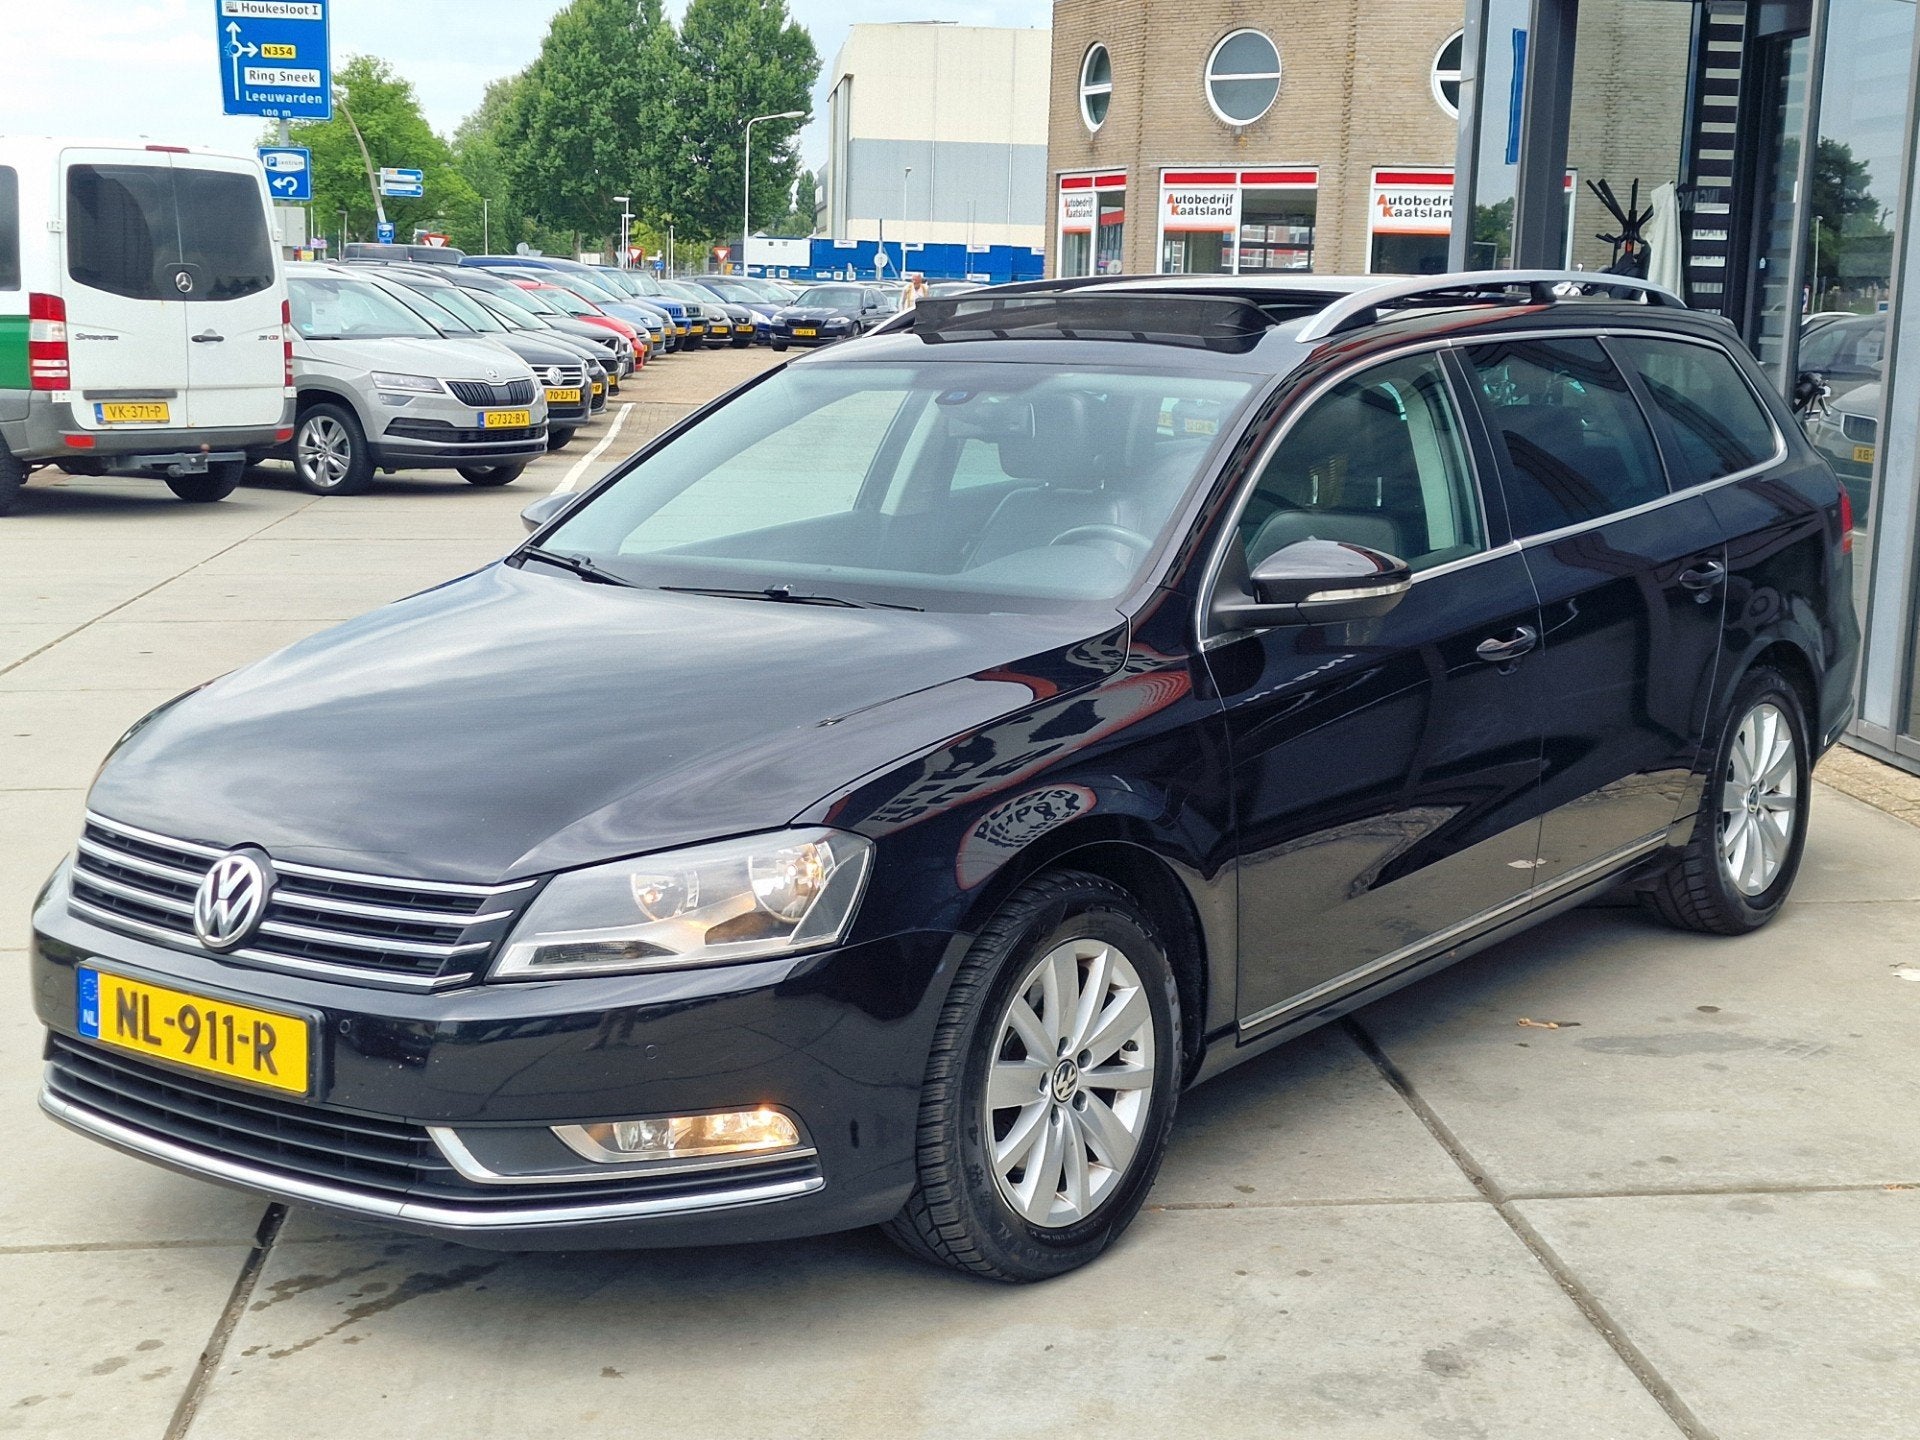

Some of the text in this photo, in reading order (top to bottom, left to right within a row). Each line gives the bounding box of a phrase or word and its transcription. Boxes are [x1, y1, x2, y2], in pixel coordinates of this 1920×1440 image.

[241, 2, 309, 15] Houkesloot
[264, 46, 293, 56] N354
[249, 70, 316, 84] Ring Sneek
[245, 90, 323, 104] Leeuwarden
[262, 108, 279, 117] 100
[1167, 193, 1234, 207] Autobedrijf
[1377, 194, 1454, 206] Autobedri
[1171, 204, 1233, 216] Kaatsland
[1382, 206, 1453, 218] Kaatslan
[109, 405, 161, 418] VK-371-P
[488, 413, 526, 426] G-732-BX
[83, 1008, 98, 1026] NL
[116, 986, 278, 1076] NL-911-R
